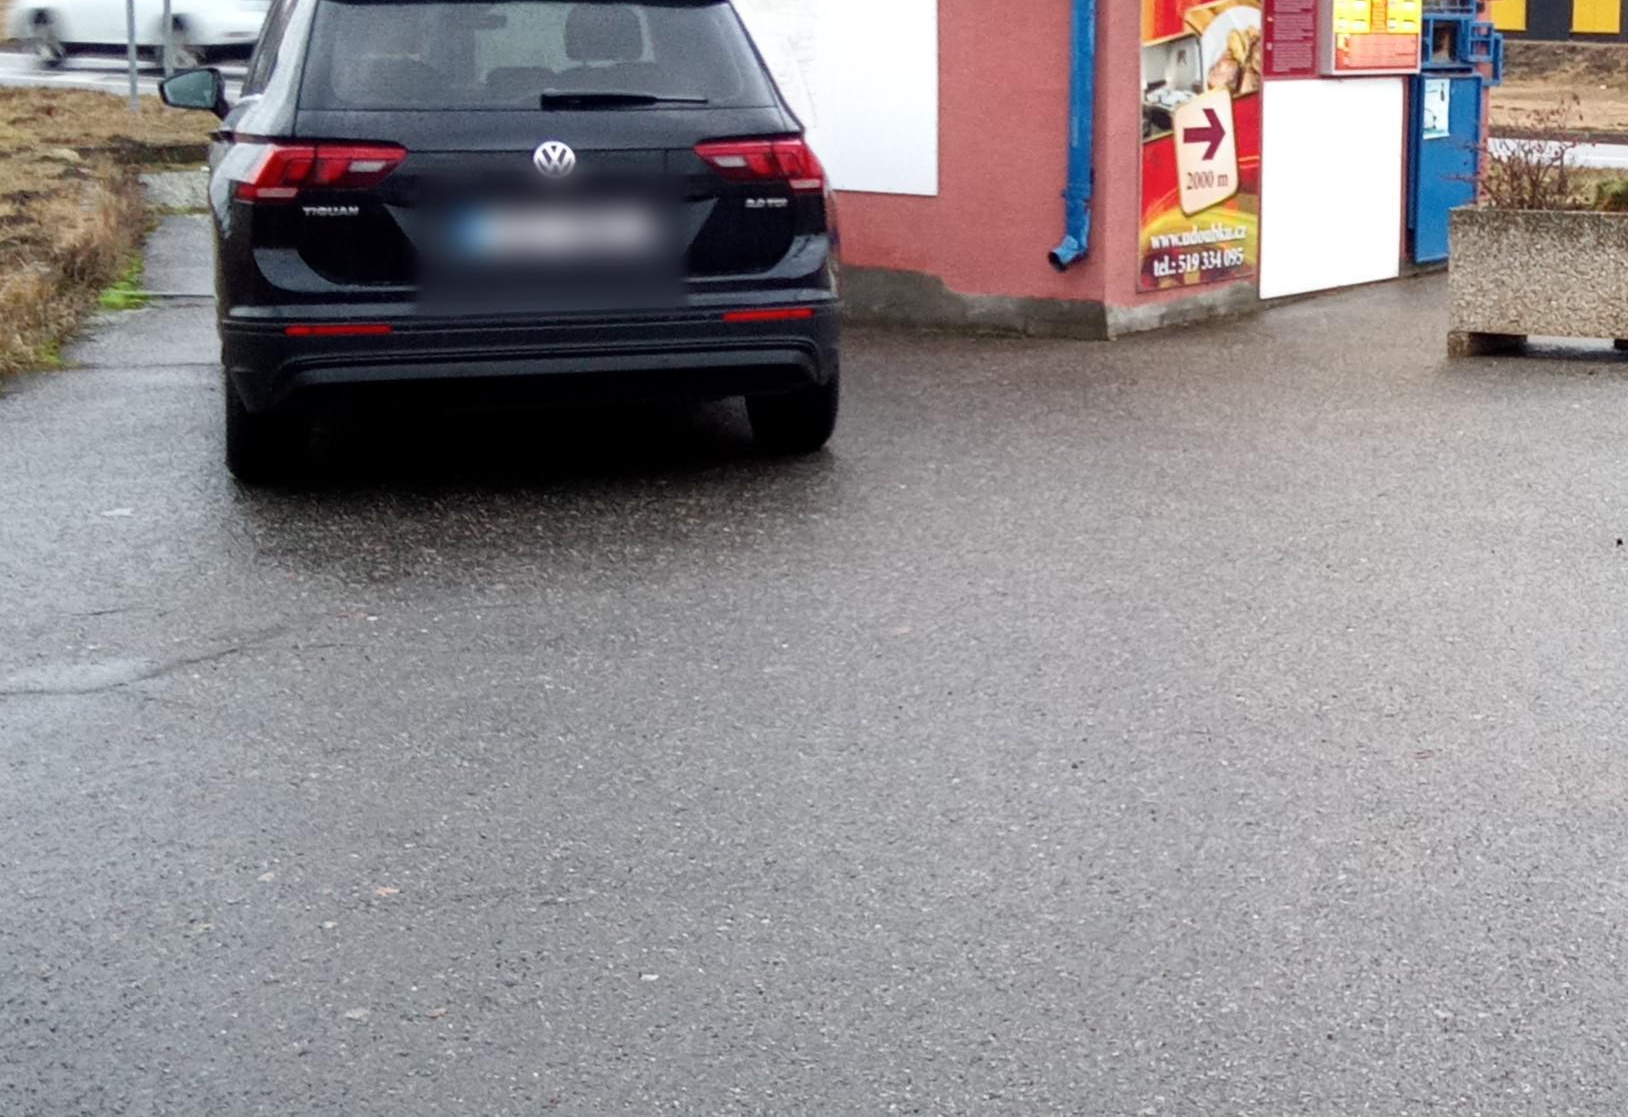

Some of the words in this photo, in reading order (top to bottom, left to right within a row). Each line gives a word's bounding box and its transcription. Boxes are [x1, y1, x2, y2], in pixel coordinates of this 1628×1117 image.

[1186, 170, 1215, 190] 2000
[1217, 173, 1229, 188] m
[1153, 255, 1177, 277] tel.:
[1178, 253, 1200, 274] 519
[1201, 249, 1222, 270] 334
[1223, 247, 1244, 267] 095
